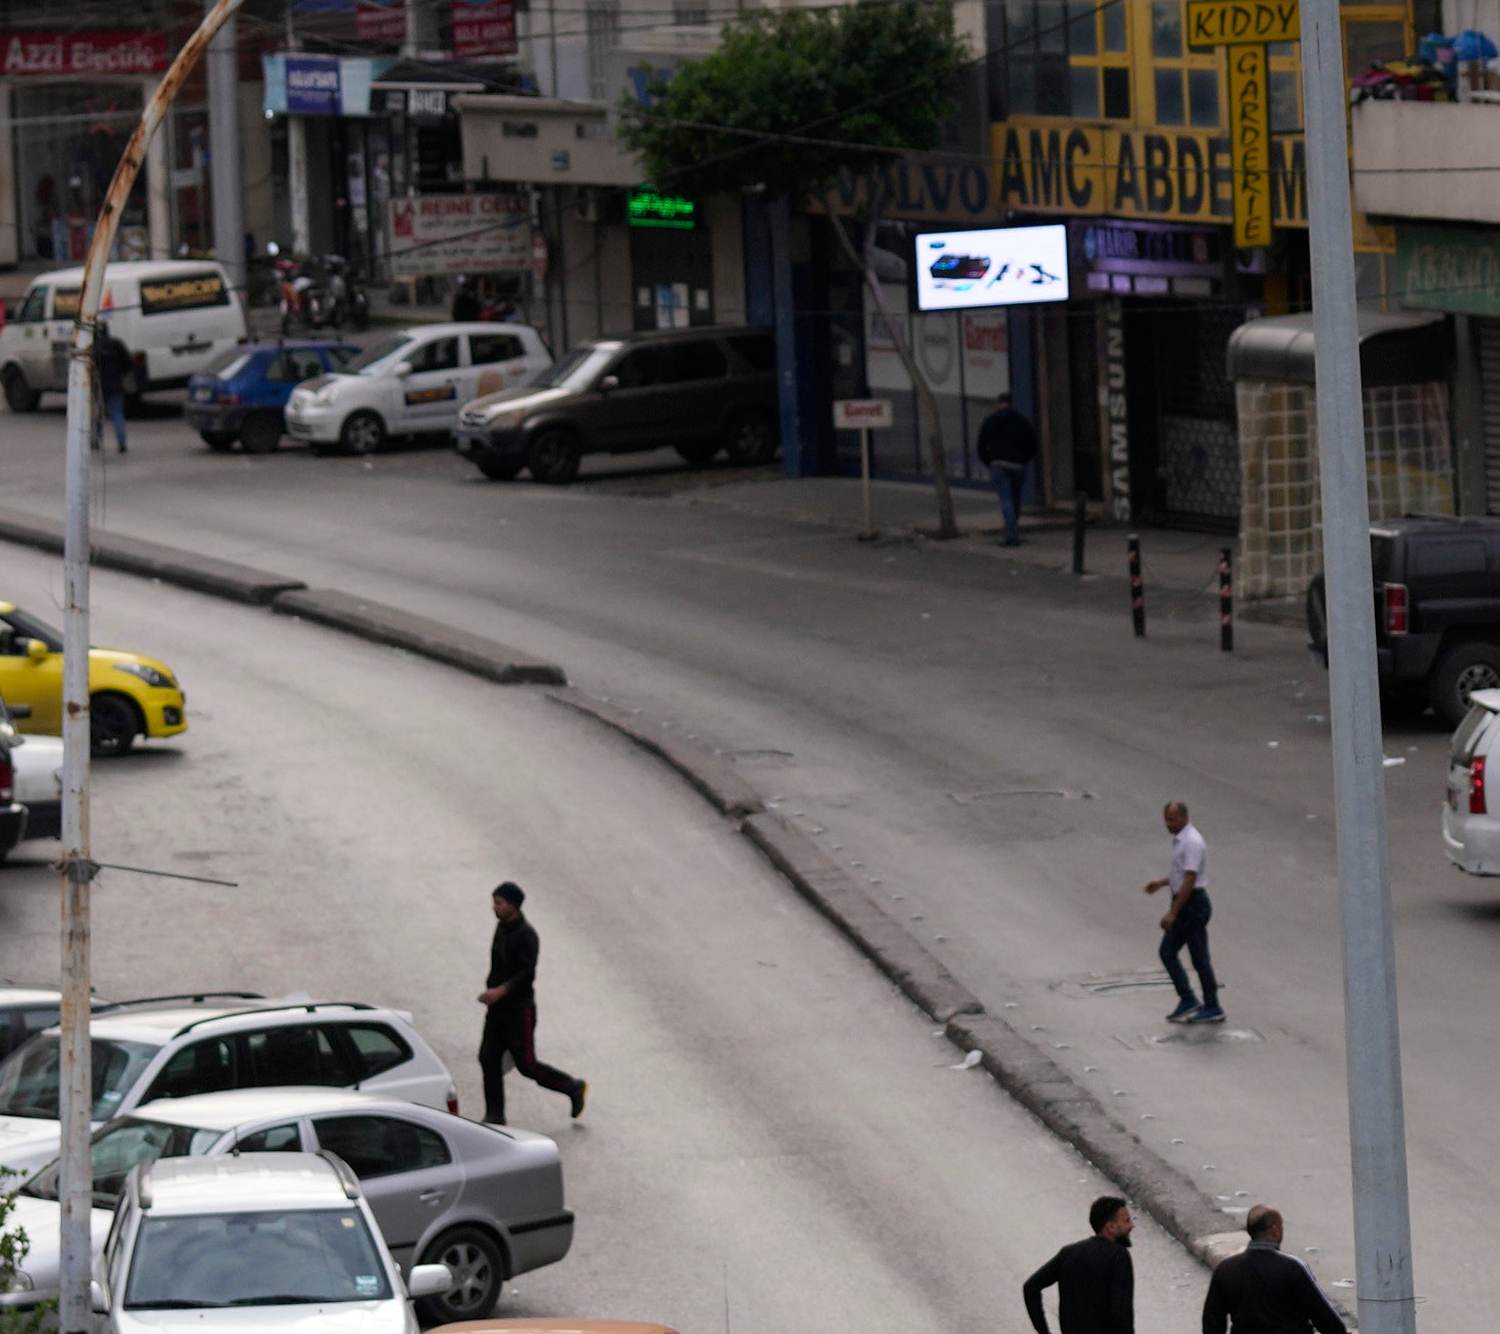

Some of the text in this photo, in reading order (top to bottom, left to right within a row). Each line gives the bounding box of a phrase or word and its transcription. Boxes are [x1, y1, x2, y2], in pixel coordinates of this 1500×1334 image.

[1195, 3, 1297, 40] KIDDY
[1002, 128, 1096, 210] AMC
[1236, 51, 1261, 242] GARDERIE
